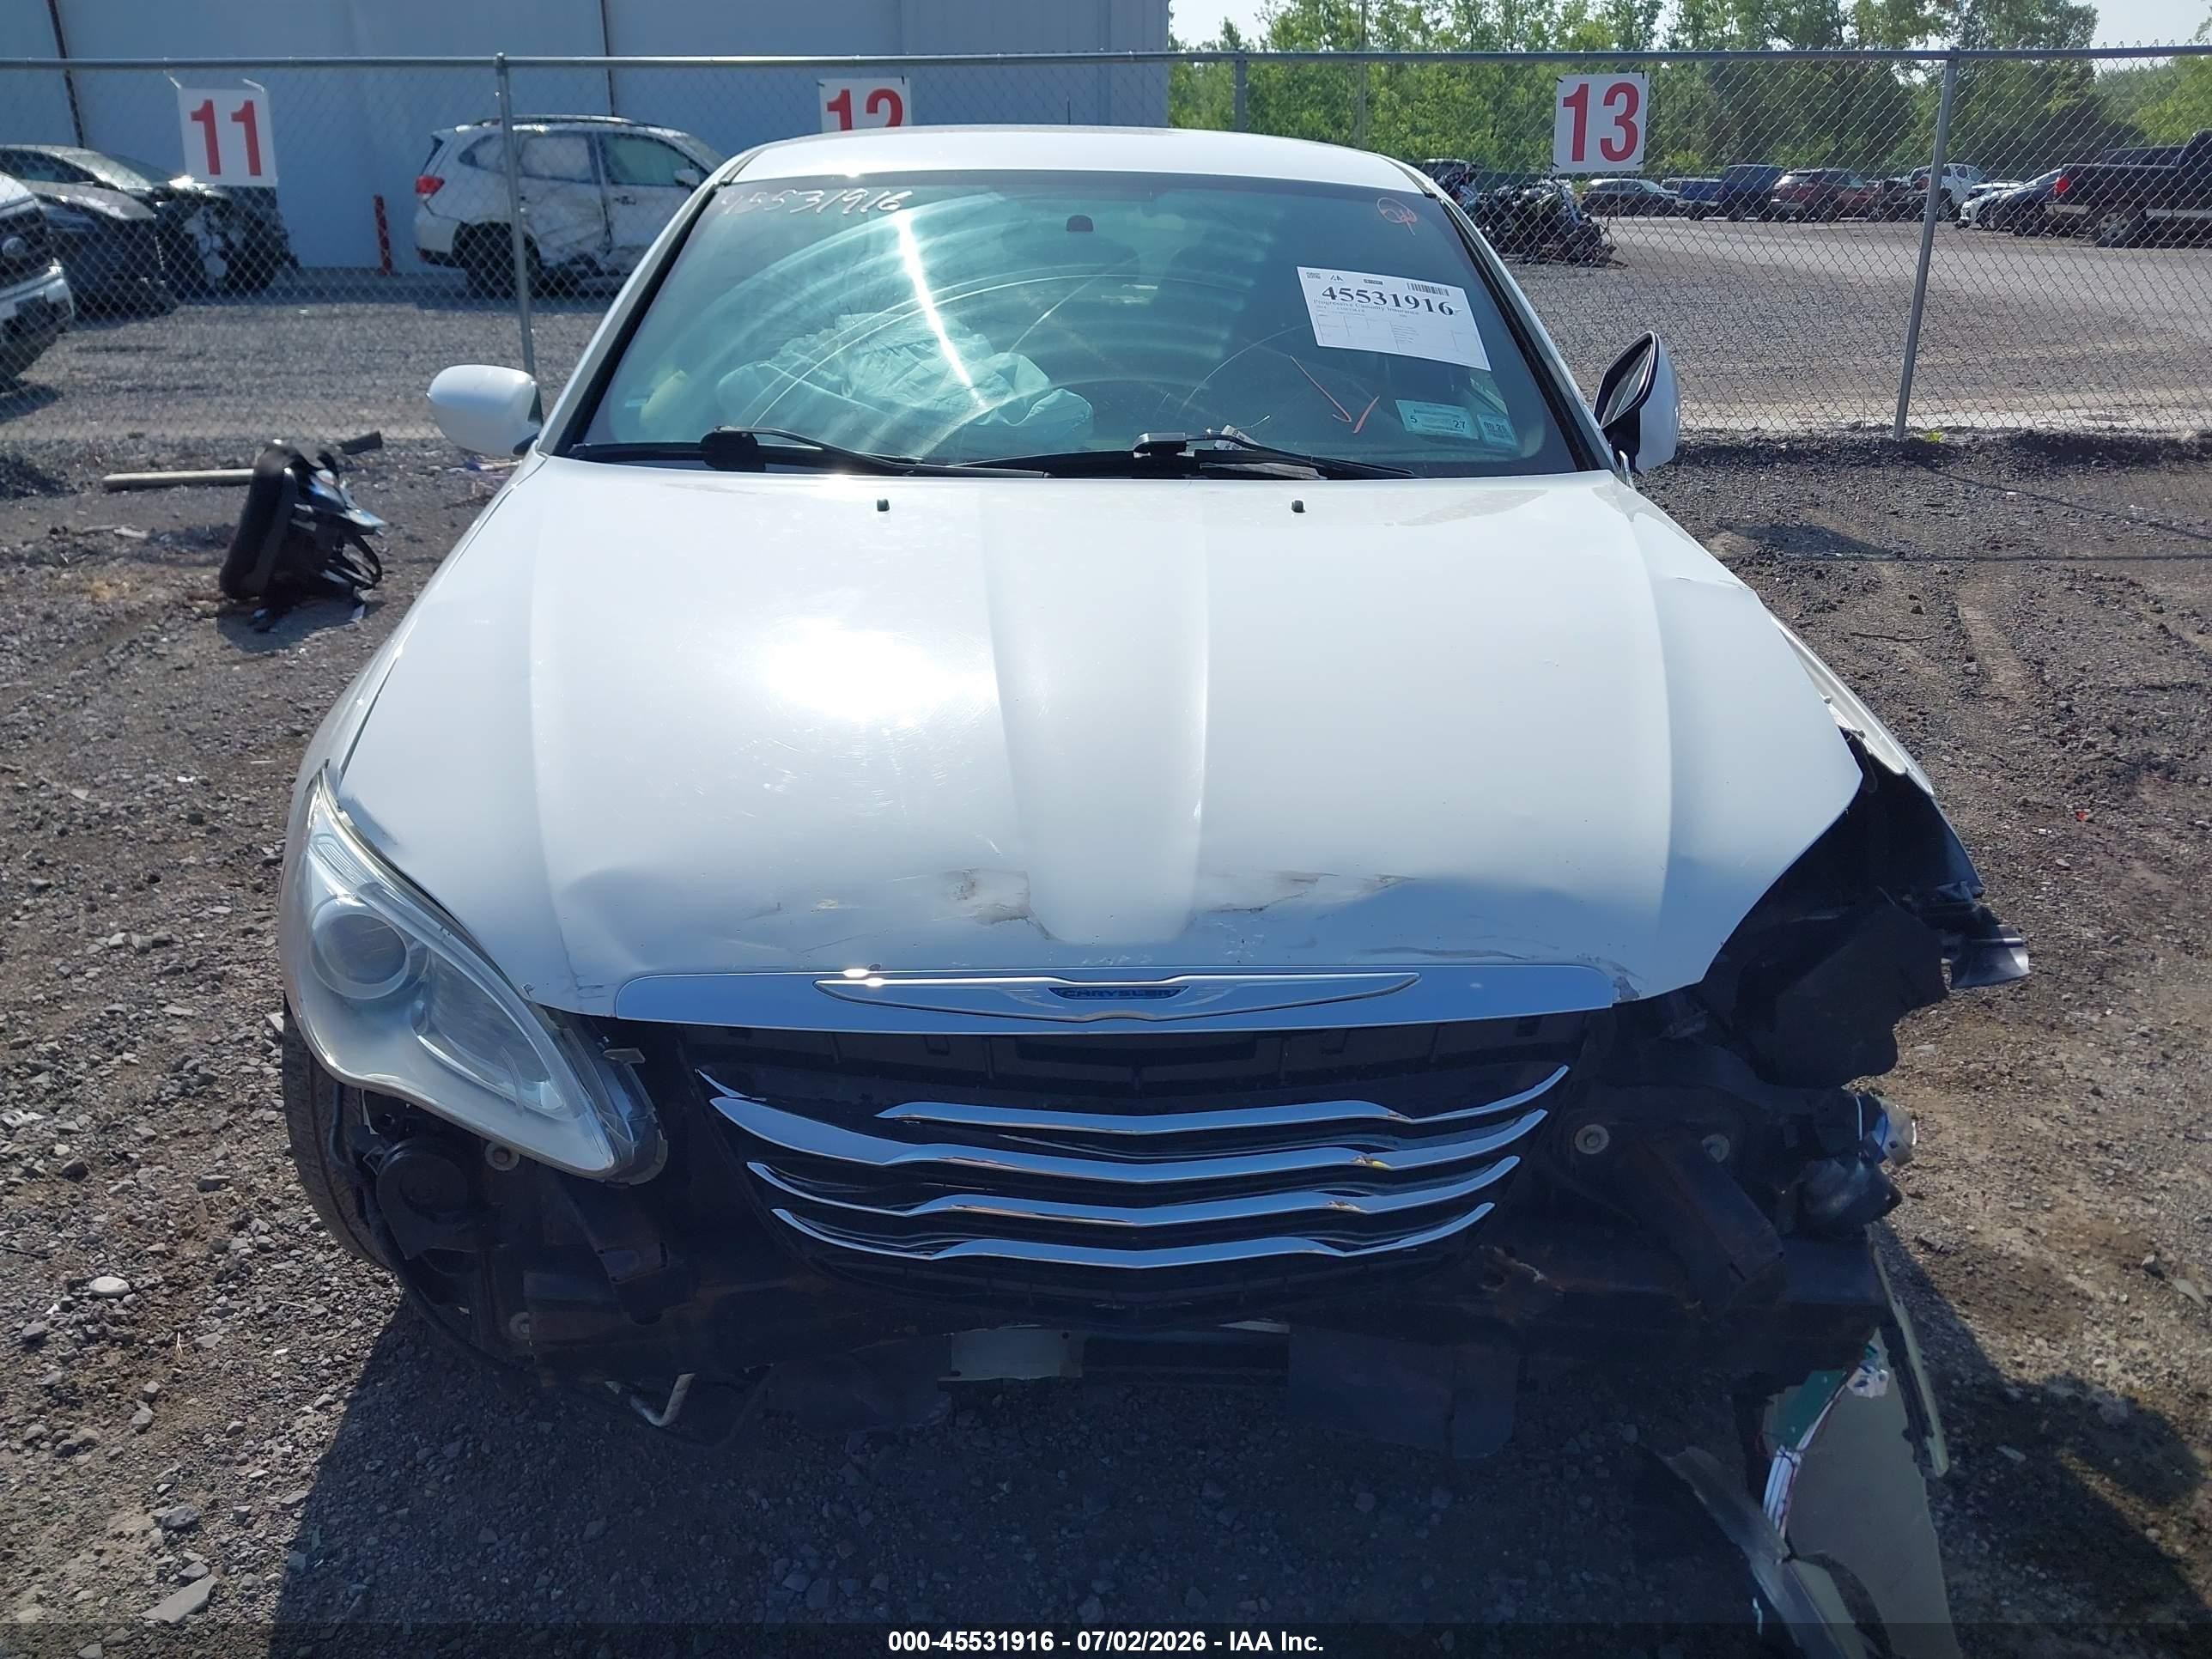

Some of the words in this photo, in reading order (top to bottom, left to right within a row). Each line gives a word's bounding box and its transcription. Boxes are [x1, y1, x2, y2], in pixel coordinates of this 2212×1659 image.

[191, 99, 261, 176] 11
[1563, 82, 1639, 162] 13
[721, 188, 913, 215] 45531916
[1322, 286, 1455, 317] 45531916
[1064, 988, 1174, 998] CHRYSLER
